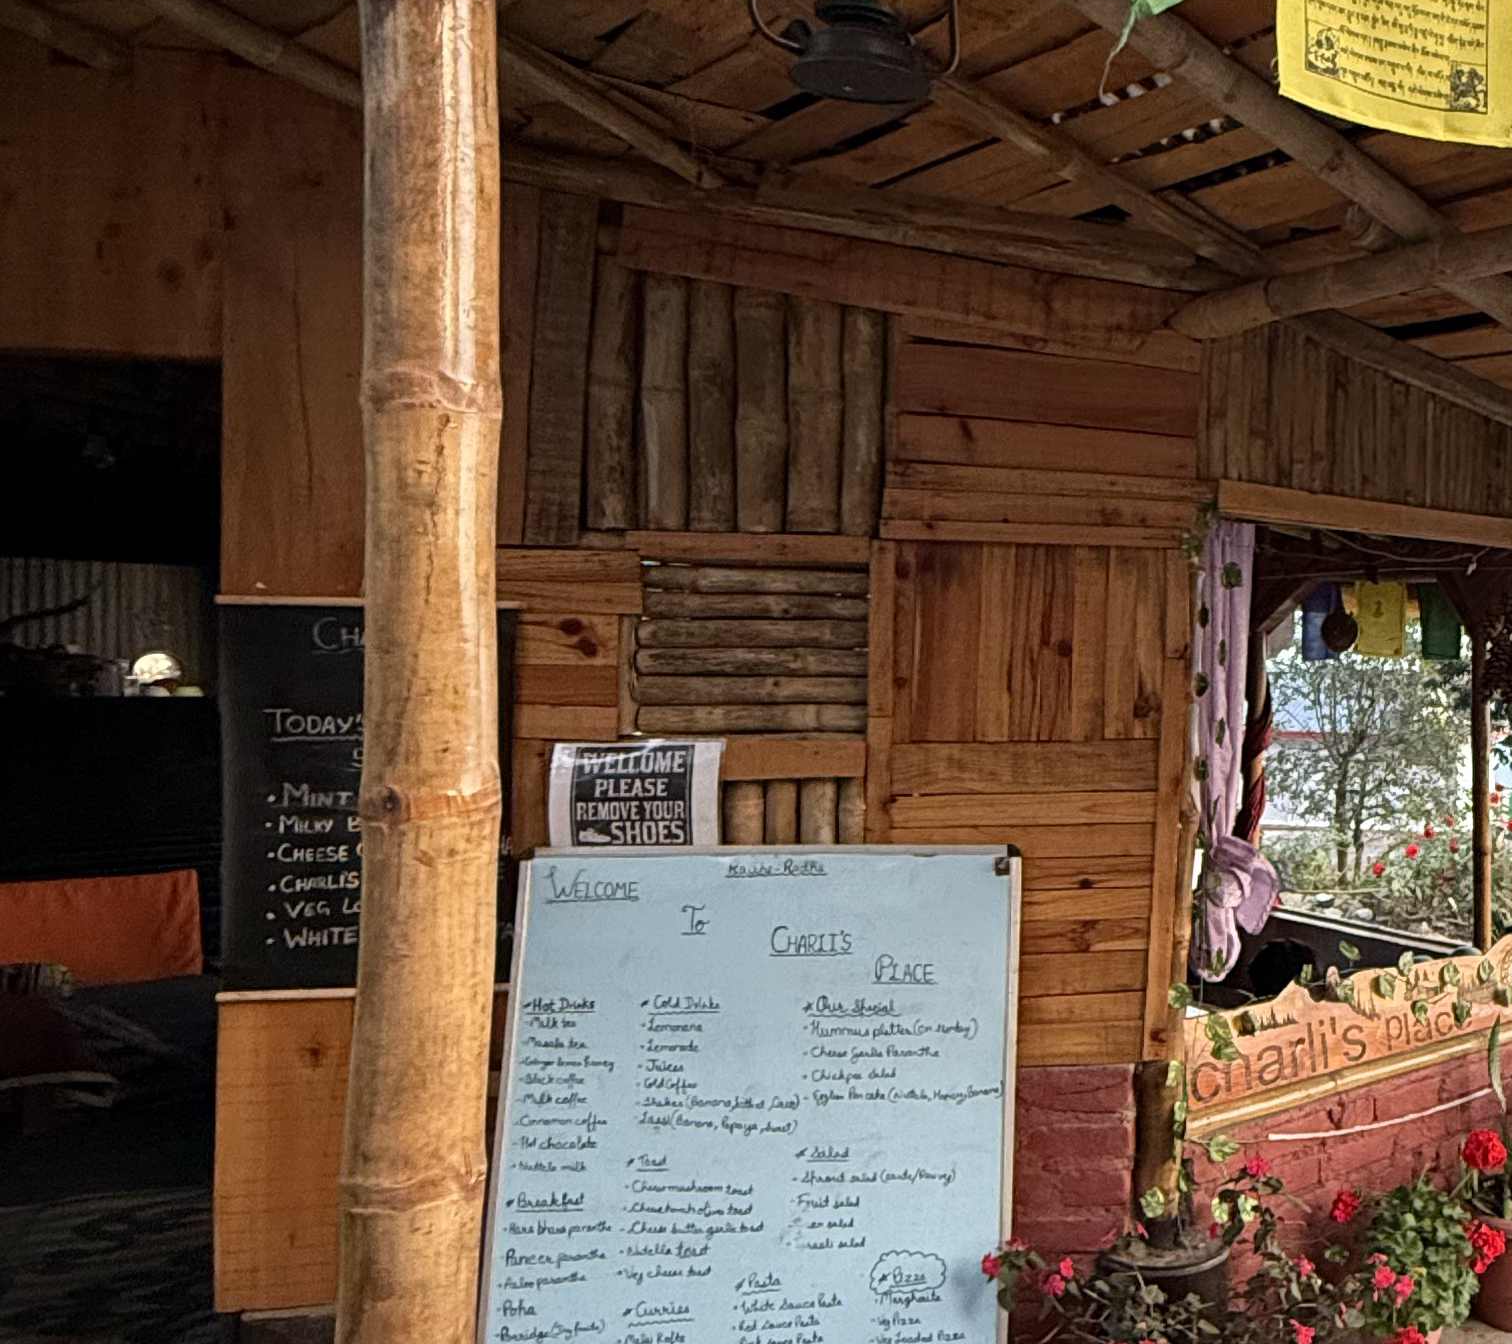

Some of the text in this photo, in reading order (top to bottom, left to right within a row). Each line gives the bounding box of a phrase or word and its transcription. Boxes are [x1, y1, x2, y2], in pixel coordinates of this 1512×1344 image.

[314, 616, 364, 651] CH
[282, 782, 353, 807] MINT
[594, 778, 669, 797] PLEASE
[576, 800, 686, 821] REMOVE YOUR
[278, 814, 333, 834] MILKY
[611, 820, 685, 845] SHOES
[277, 843, 349, 863] CHEESE
[545, 865, 639, 898] WELCOME
[284, 900, 331, 919] VEG
[283, 926, 359, 949] WHITE
[532, 996, 596, 1013] Hot Drinks
[653, 994, 680, 1009] Cold
[529, 1016, 558, 1029] Milk
[646, 1058, 684, 1072] Juices
[643, 1077, 665, 1089] Cold
[523, 1092, 552, 1104] Milk
[539, 1136, 597, 1150] chocolate
[516, 1191, 584, 1208] Breakfast
[797, 1193, 830, 1208] Fruit
[748, 1272, 782, 1288] Pasta
[502, 1298, 537, 1317] Poha
[635, 1300, 690, 1318] Curries
